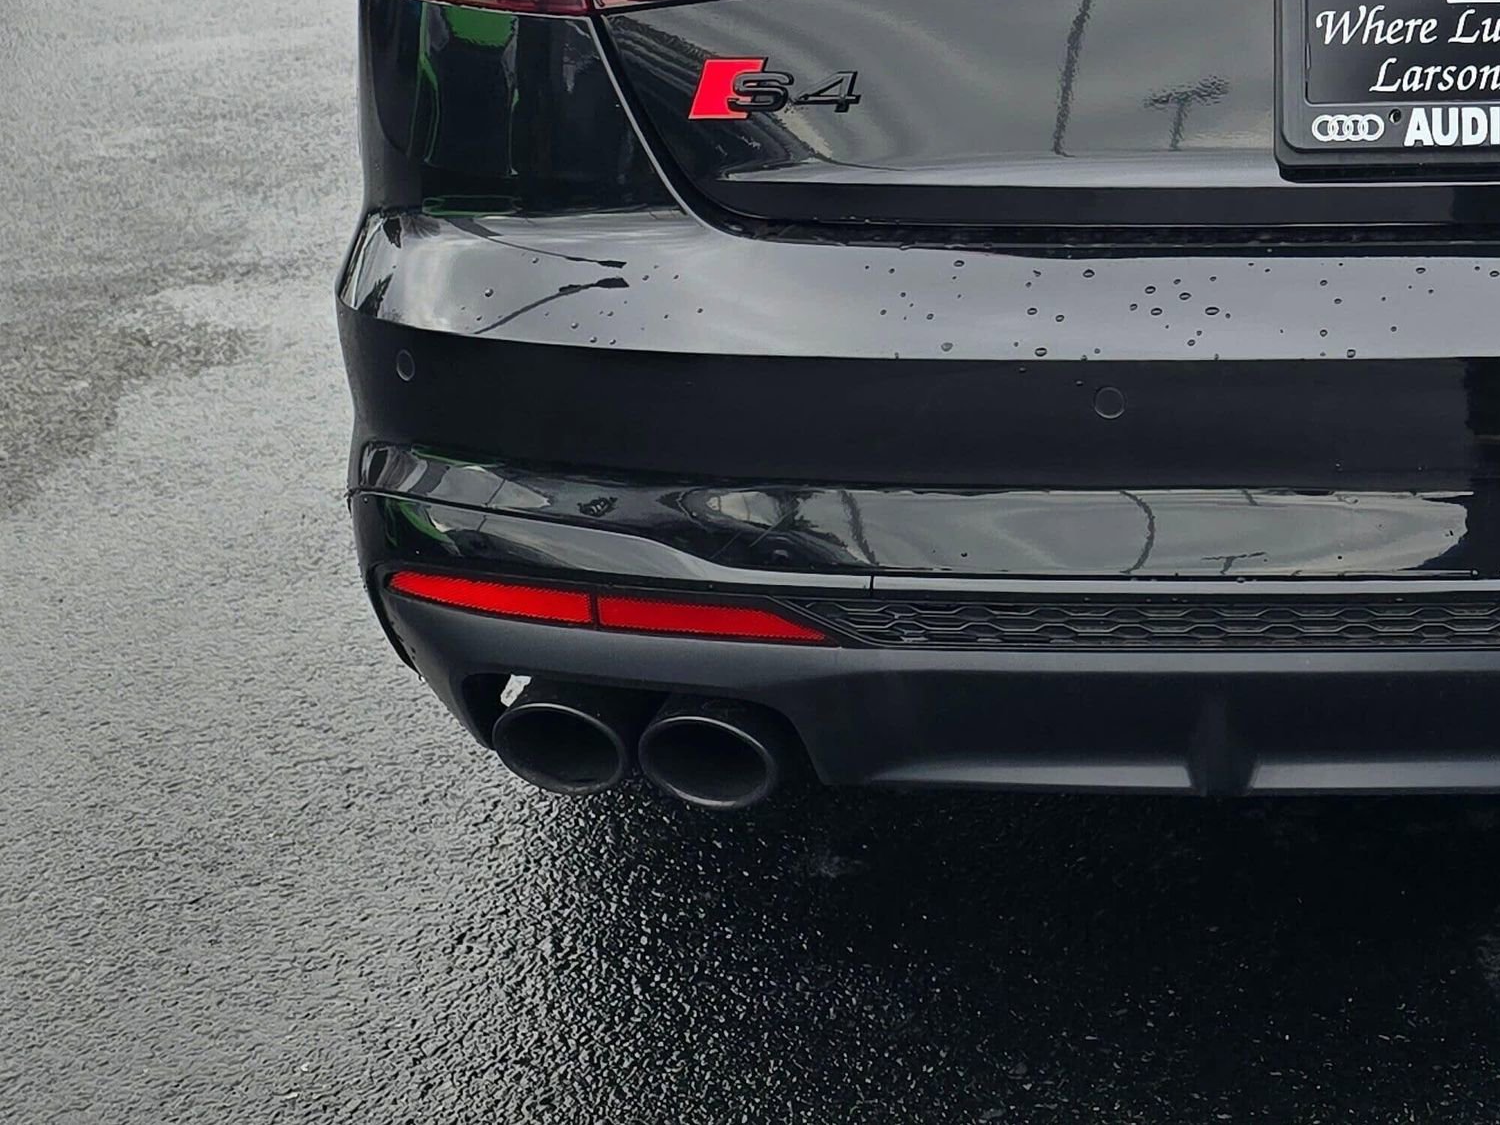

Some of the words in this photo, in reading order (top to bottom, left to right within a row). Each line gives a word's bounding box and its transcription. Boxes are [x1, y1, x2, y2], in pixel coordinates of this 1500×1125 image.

[1315, 4, 1438, 46] Where
[726, 70, 862, 113] S4
[1403, 106, 1500, 148] AUDI
